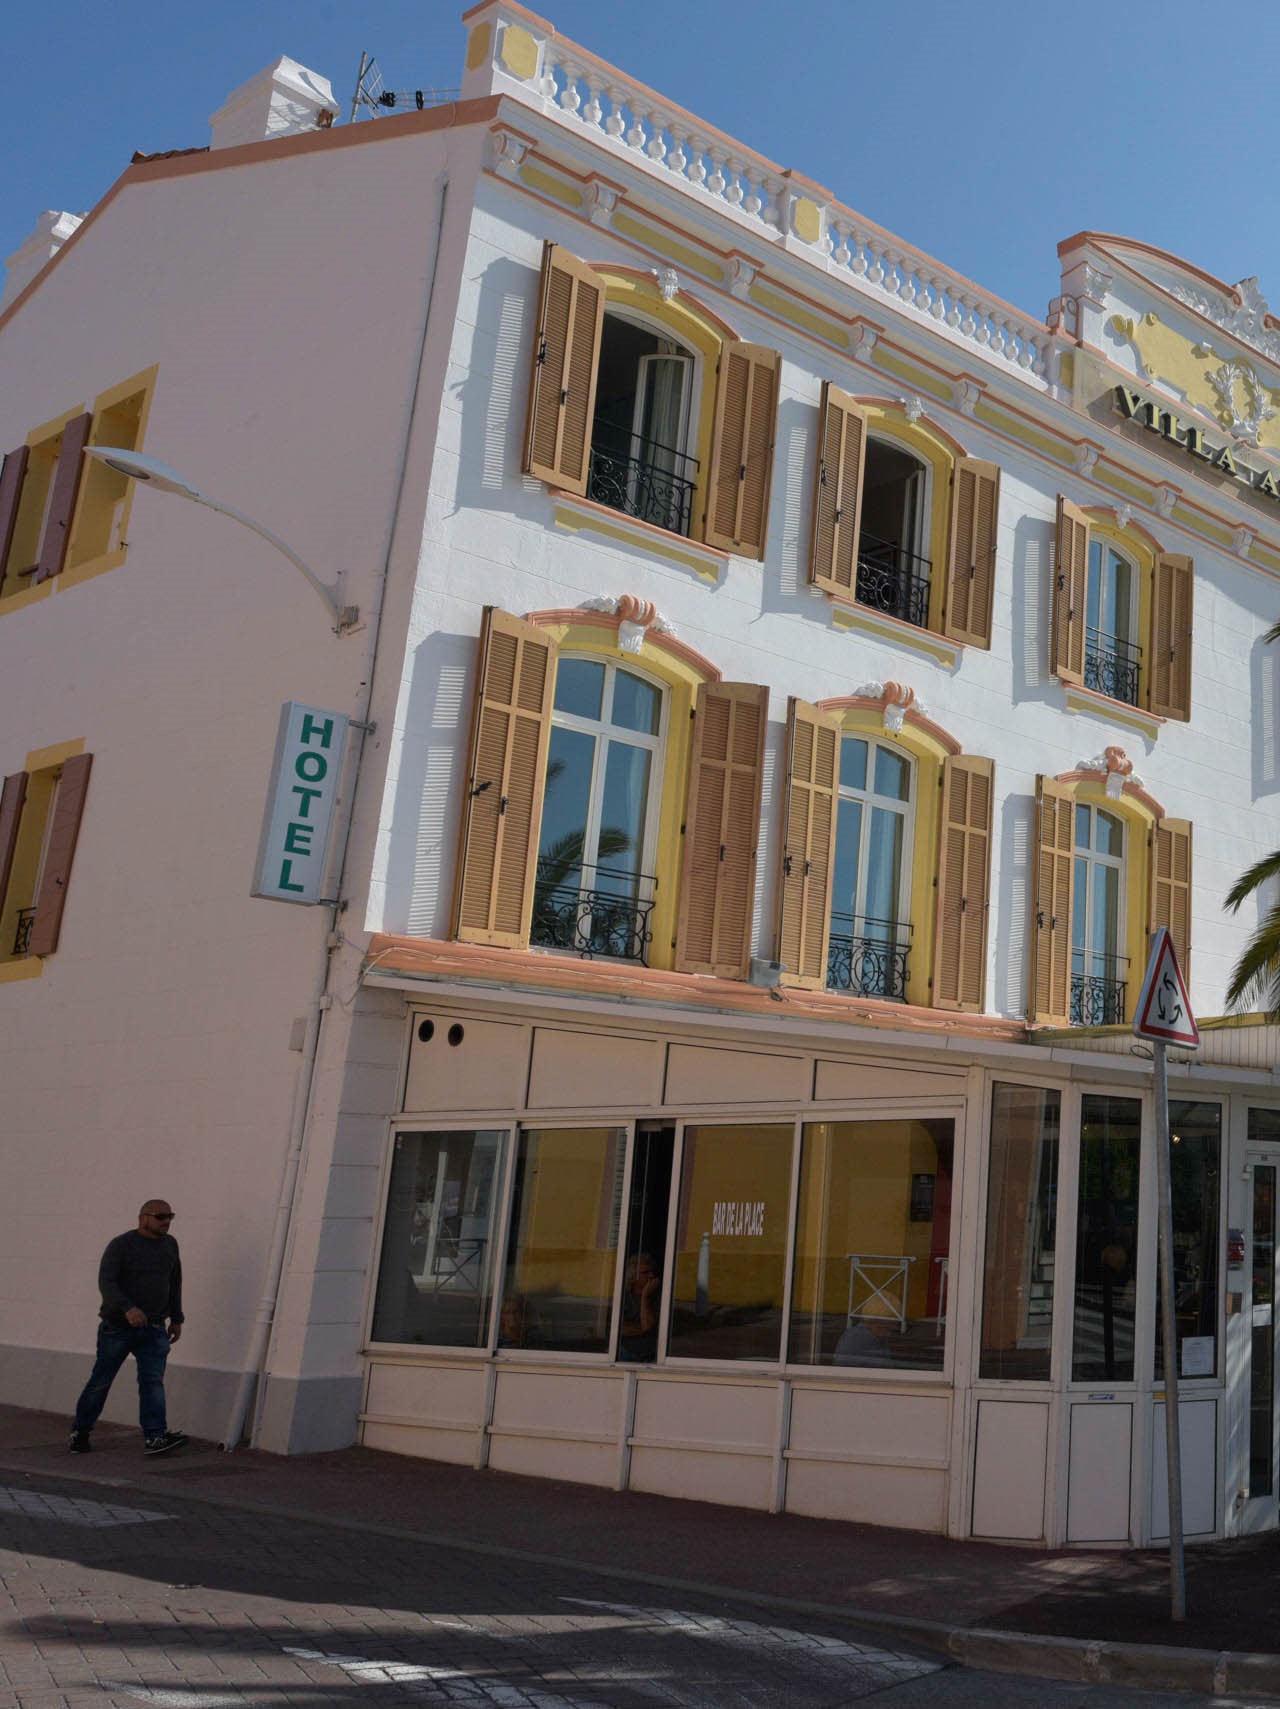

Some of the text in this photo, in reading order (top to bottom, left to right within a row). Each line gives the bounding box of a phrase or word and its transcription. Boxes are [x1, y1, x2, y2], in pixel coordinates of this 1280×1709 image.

[1113, 385, 1237, 477] VILLA
[278, 714, 334, 893] HOTEL
[712, 1202, 766, 1236] BAR DE LA PLACE
